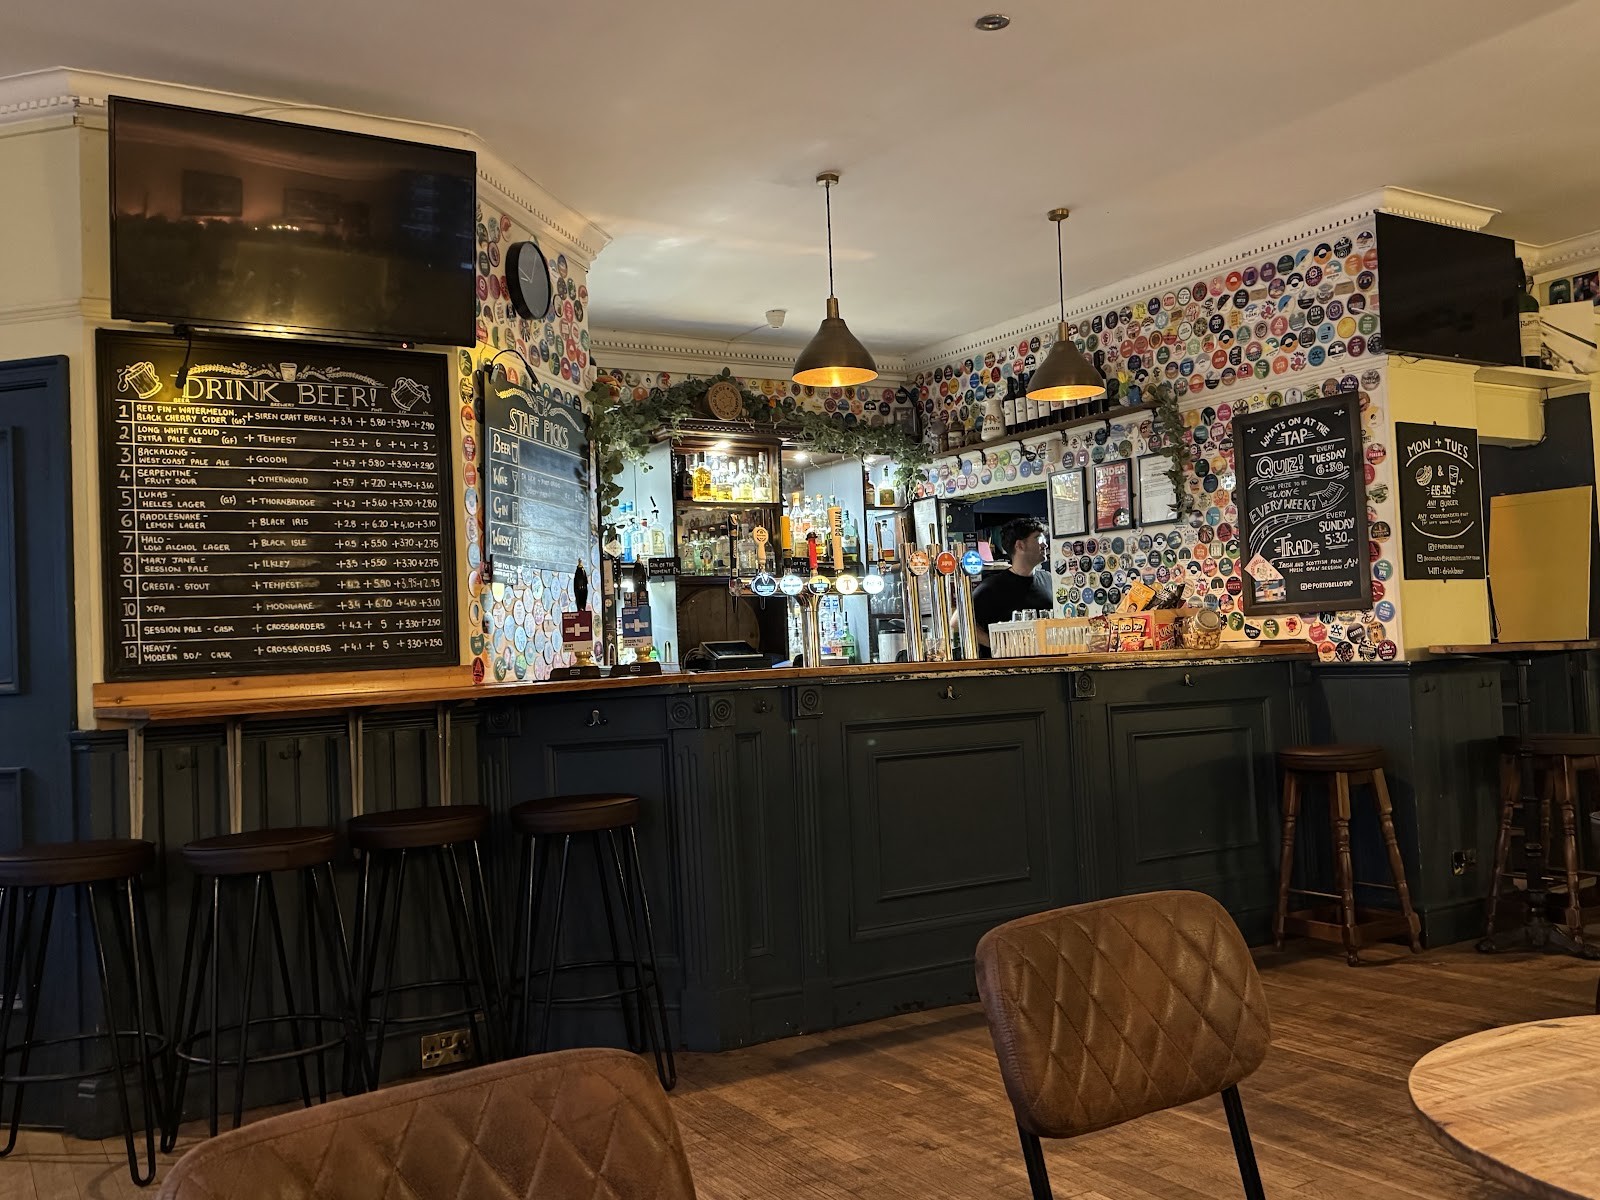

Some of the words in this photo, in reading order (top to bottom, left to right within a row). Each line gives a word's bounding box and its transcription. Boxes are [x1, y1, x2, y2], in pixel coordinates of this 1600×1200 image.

[182, 377, 280, 402] DRINK
[298, 384, 377, 407] BEER!
[119, 405, 129, 417] 1
[137, 413, 162, 422] BLACK
[165, 414, 196, 423] CHERRY
[202, 416, 227, 424] CIDER
[119, 426, 130, 440] 2
[509, 408, 540, 438] STAFF
[543, 420, 569, 449] PICKS
[1260, 421, 1285, 447] WHAT'S
[1288, 417, 1300, 426] ON
[1303, 417, 1316, 426] AT
[1316, 422, 1330, 436] THE
[257, 435, 296, 444] TEMPEST
[1281, 428, 1307, 446] TAP
[121, 448, 131, 462] 3
[1317, 444, 1334, 452] EVERY
[1407, 439, 1430, 457] MON
[1444, 438, 1468, 458] TUES
[1256, 454, 1304, 479] QUIZ!
[1309, 448, 1346, 464] TUESDAY
[120, 470, 130, 481] 4
[122, 491, 131, 506] 5
[259, 497, 315, 506] THORNBRIDGE
[494, 497, 508, 517] GIN
[1249, 500, 1281, 524] EVERY
[1284, 499, 1316, 511] WEEK!
[121, 514, 132, 527] 6
[1319, 518, 1354, 532] SUNDAY
[123, 536, 133, 548] 7
[1274, 533, 1313, 557] TRAD
[123, 557, 133, 573] 8
[263, 560, 290, 568] ILKLEY
[124, 579, 132, 593] 9
[123, 603, 136, 616] 10
[124, 624, 136, 638] 11
[125, 646, 137, 658] 12
[266, 645, 331, 653] CROSSBORDERS
